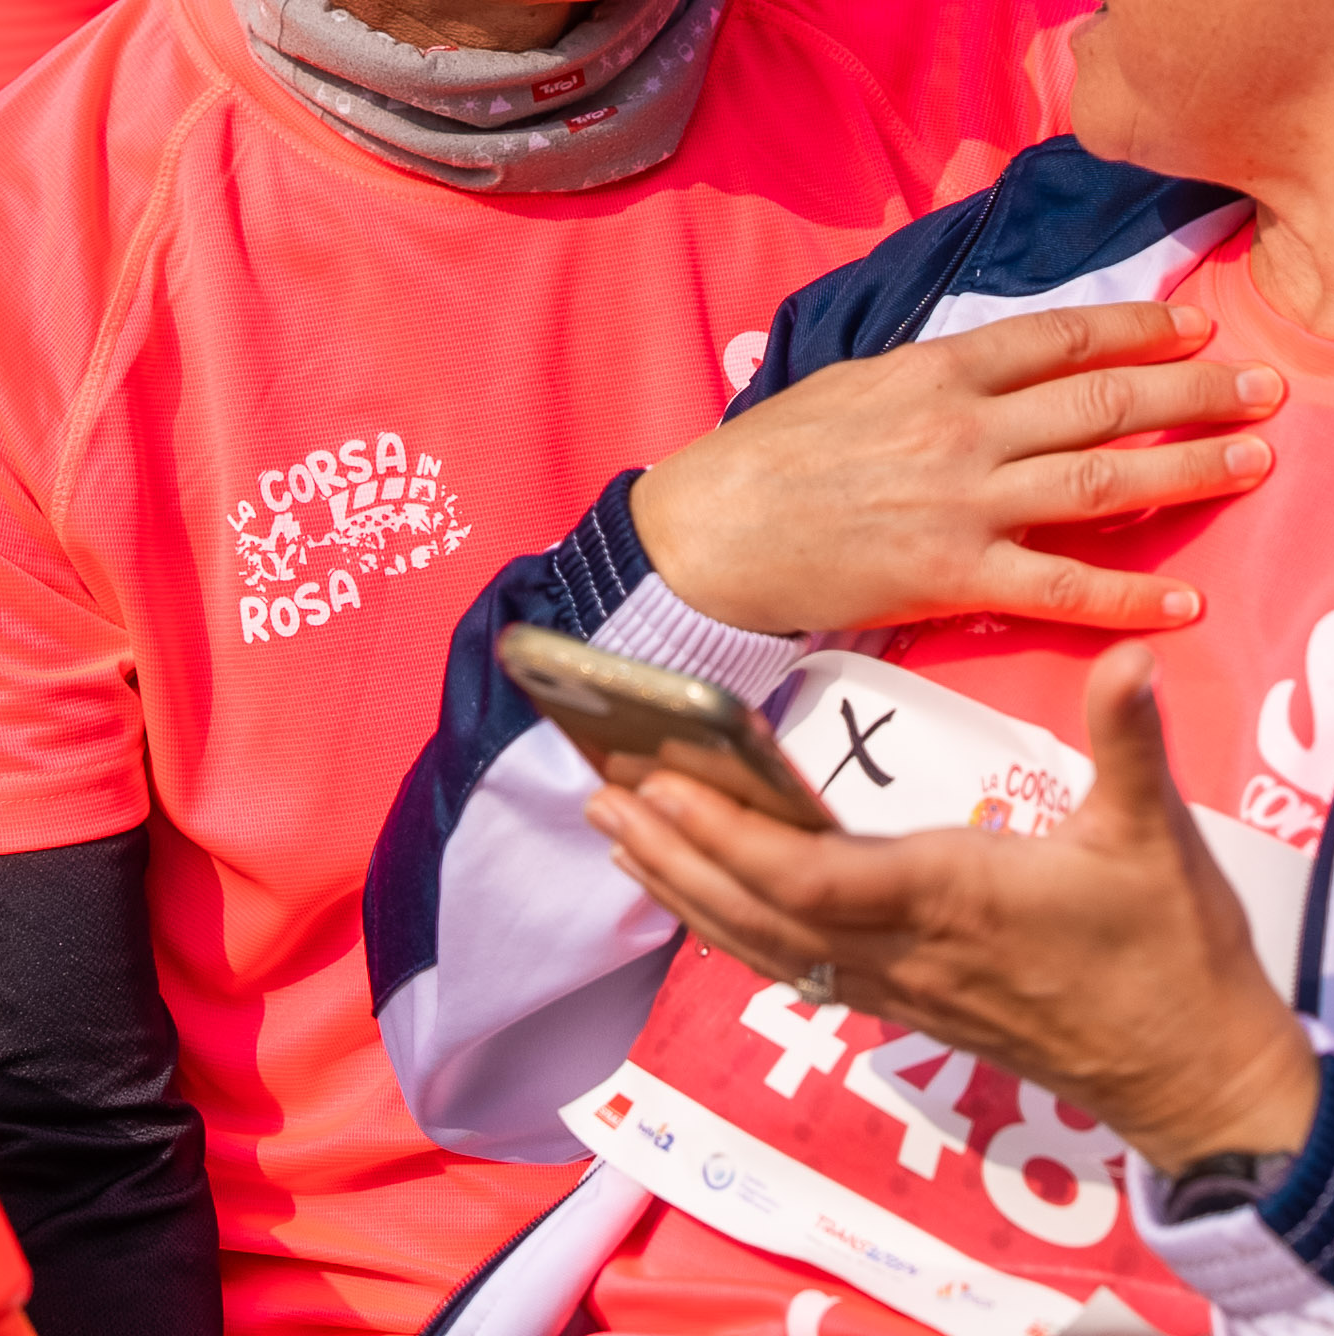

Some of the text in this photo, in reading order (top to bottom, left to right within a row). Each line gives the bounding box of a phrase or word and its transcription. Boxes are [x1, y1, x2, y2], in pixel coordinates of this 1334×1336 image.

[227, 431, 442, 532] LA CORSA IN
[240, 567, 361, 644] ROSA
[980, 763, 1071, 814] LA CORSA
[739, 981, 1128, 1248] 448
